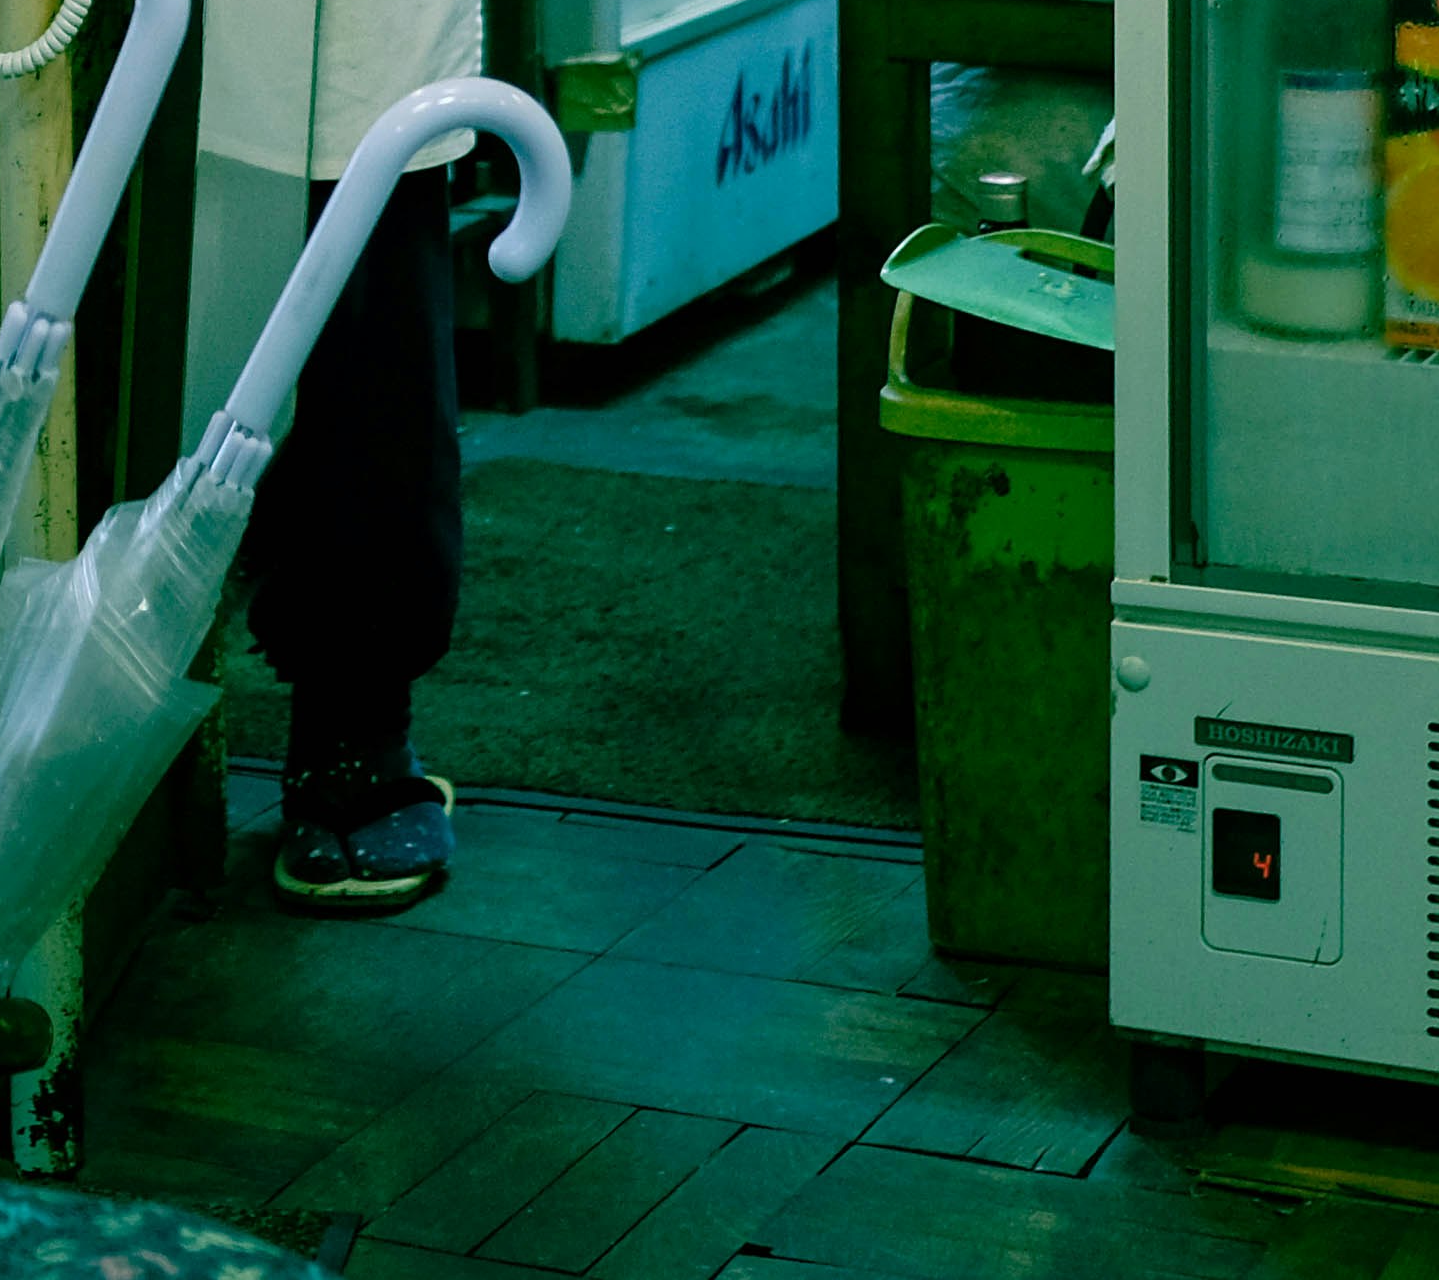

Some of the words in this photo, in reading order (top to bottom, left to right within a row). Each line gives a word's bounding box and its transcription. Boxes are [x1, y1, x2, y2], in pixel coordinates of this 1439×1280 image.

[716, 39, 811, 189] Asahi
[1207, 722, 1342, 756] HOSHIZAKI
[1252, 851, 1272, 879] 4
